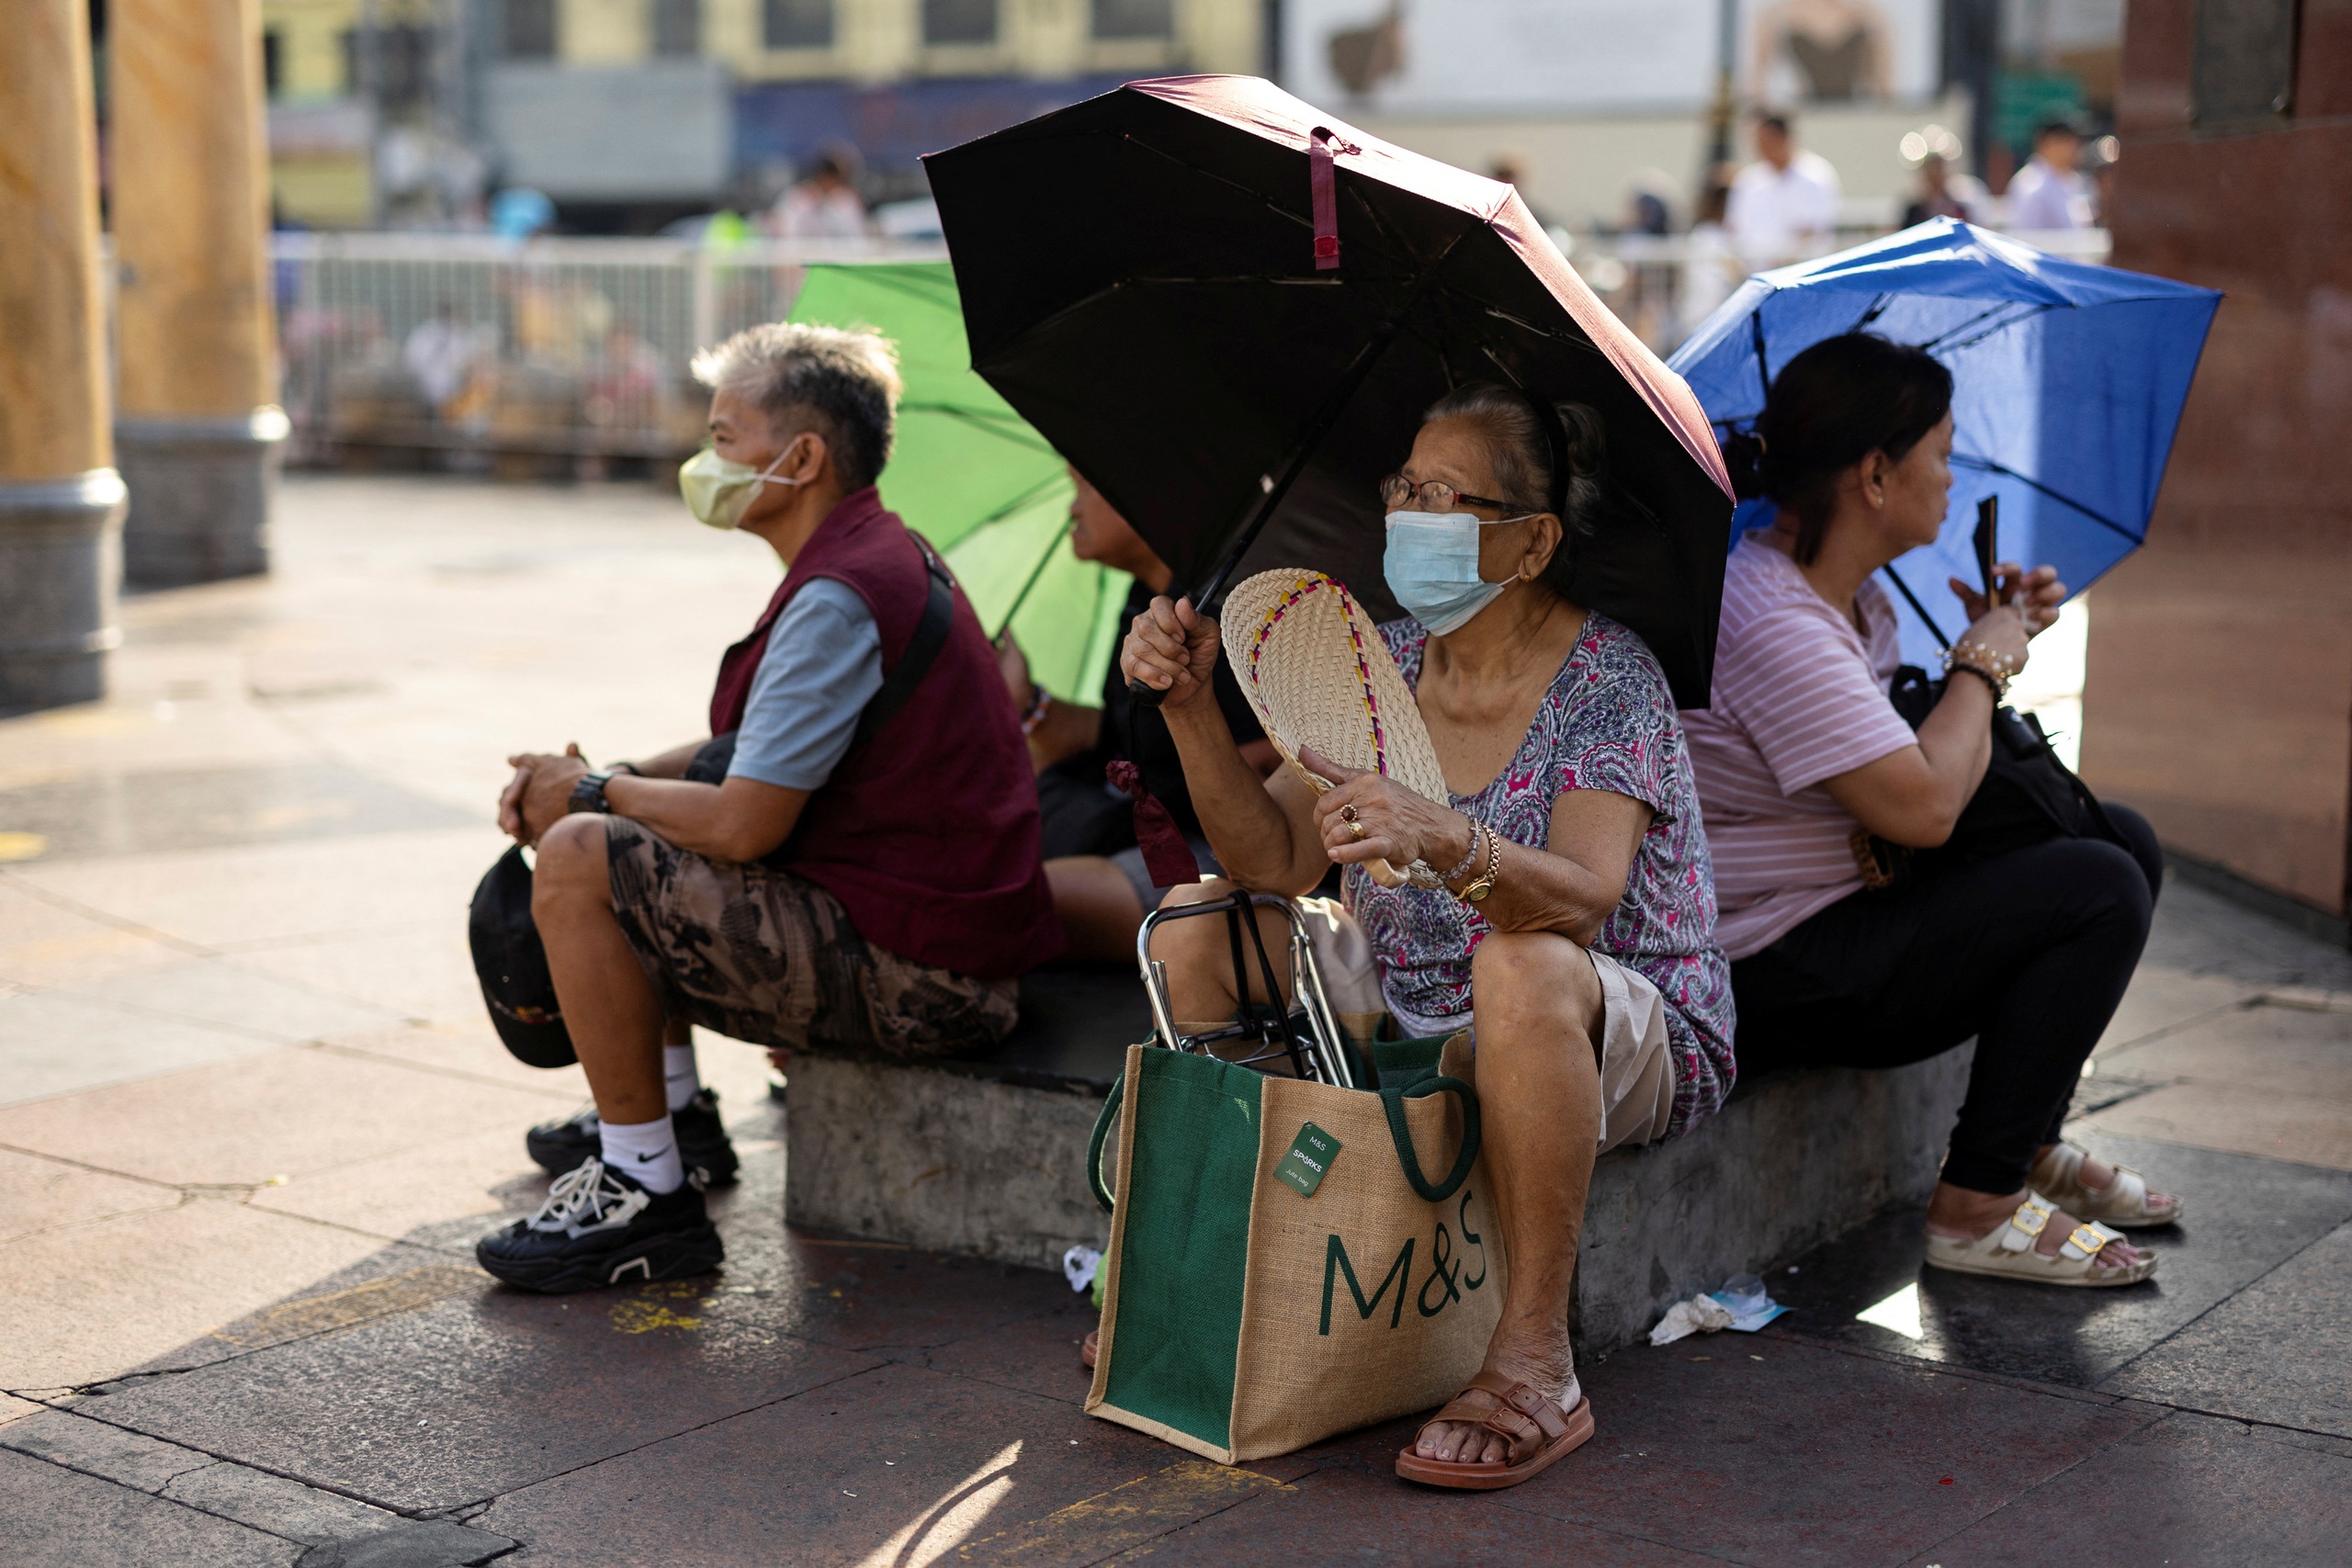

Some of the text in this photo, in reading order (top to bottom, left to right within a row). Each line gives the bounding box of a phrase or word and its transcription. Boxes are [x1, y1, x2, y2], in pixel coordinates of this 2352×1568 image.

[1309, 1136, 1327, 1151] M&S
[1293, 1149, 1323, 1172] SPARKS
[1285, 1169, 1309, 1187] Jute bag
[1318, 1190, 1487, 1336] M&S
